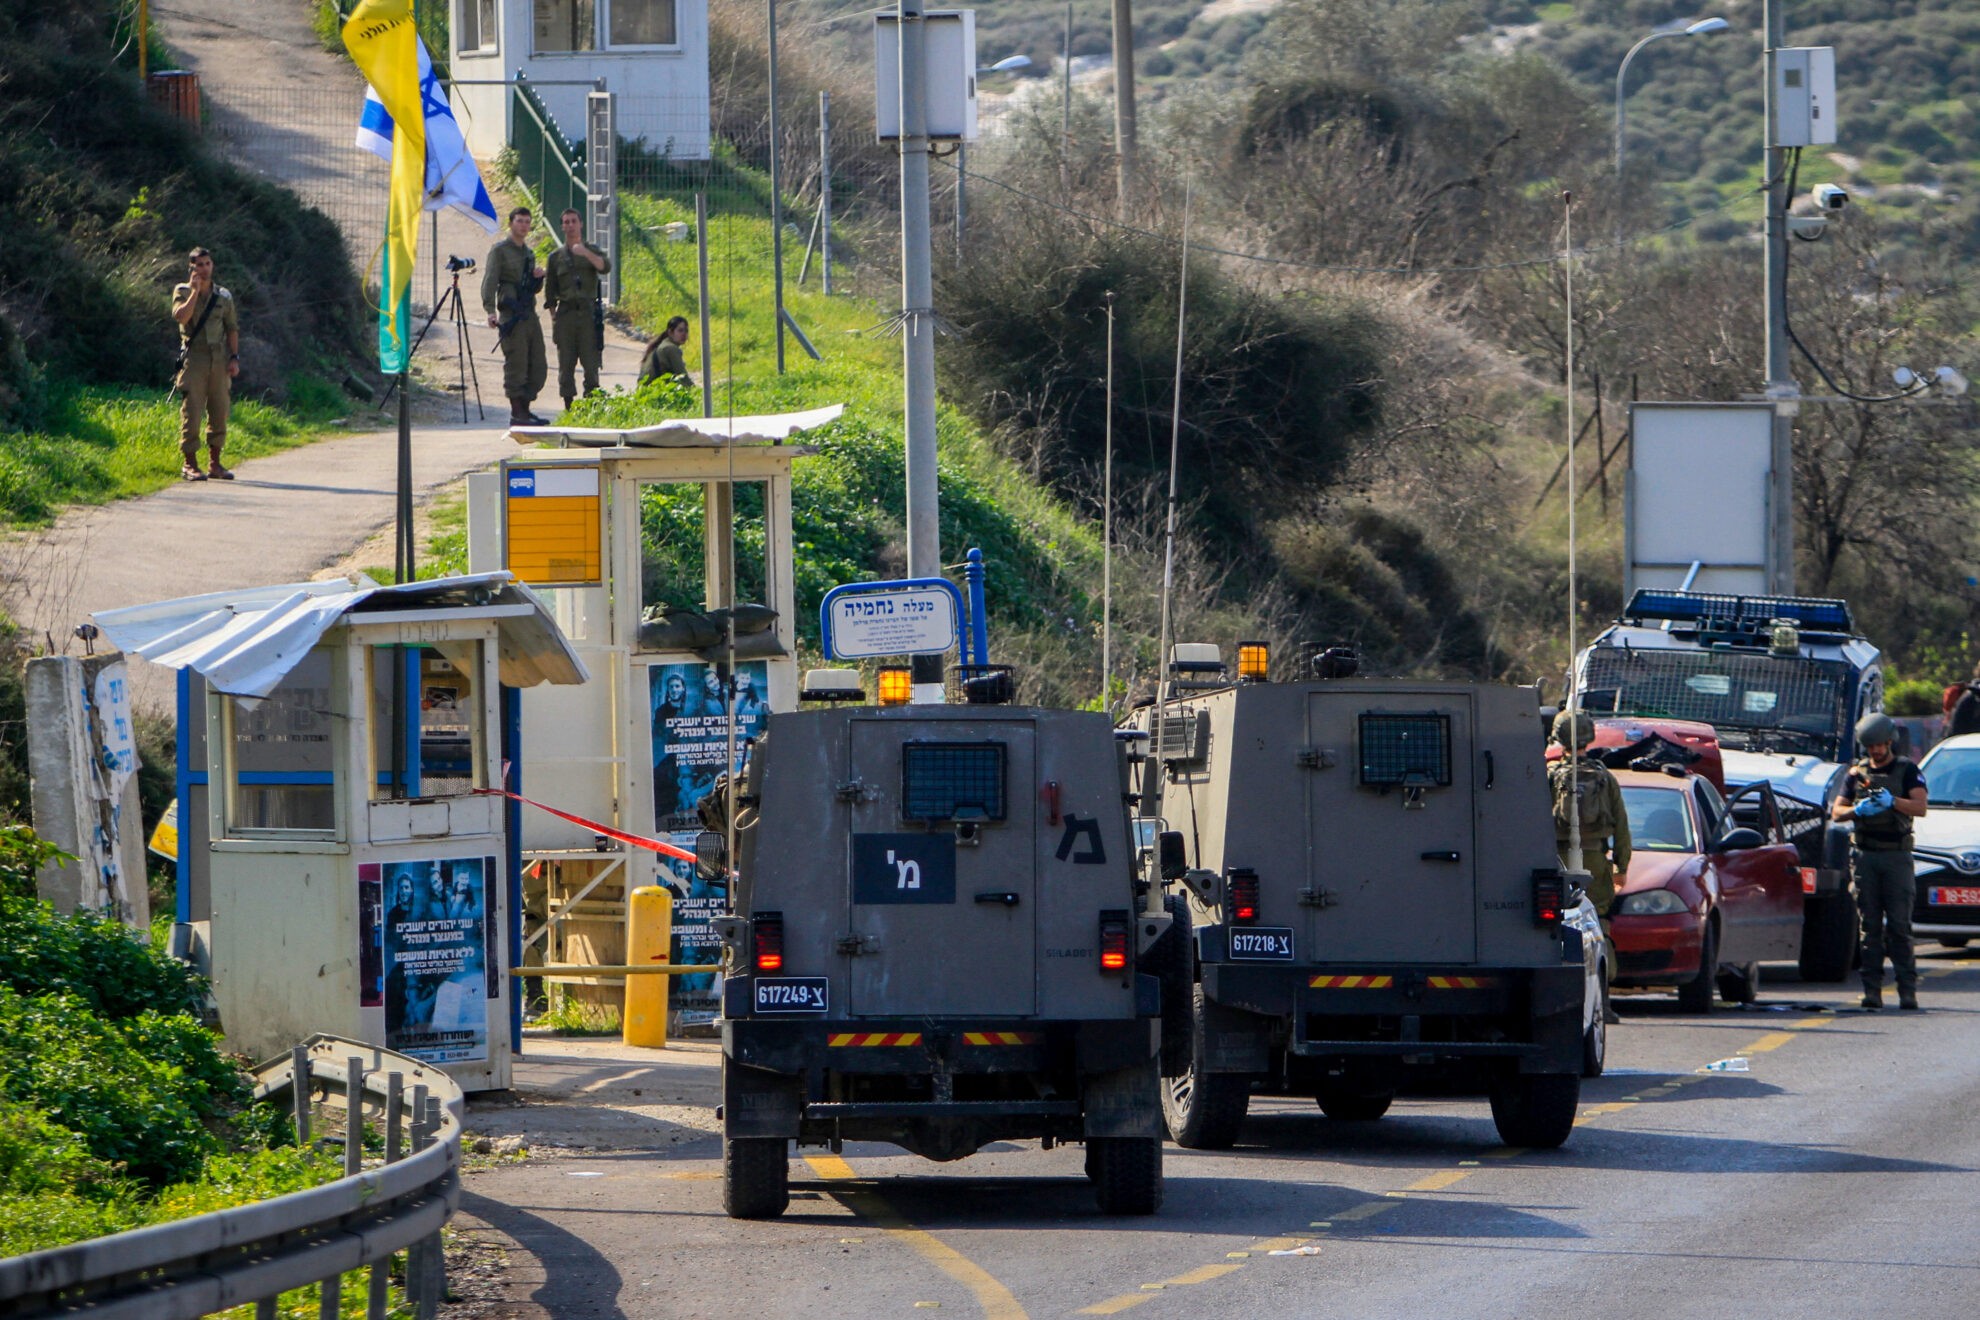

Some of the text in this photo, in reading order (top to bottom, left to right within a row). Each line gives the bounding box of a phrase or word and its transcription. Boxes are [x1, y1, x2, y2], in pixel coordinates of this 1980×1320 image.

[844, 598, 934, 617] מעלה נחמיה
[666, 717, 700, 728] יושבים
[738, 714, 756, 724] שני
[672, 727, 706, 738] מנהלי
[664, 743, 702, 754] ומשפט
[672, 898, 706, 908] יושבים
[679, 908, 711, 919] מנהלי
[396, 918, 473, 932] שני יהודים יושבים
[671, 925, 708, 934] ומשפט
[402, 930, 464, 944] במעצר מנהלי
[394, 946, 474, 962] ללא ראיות ומשפט
